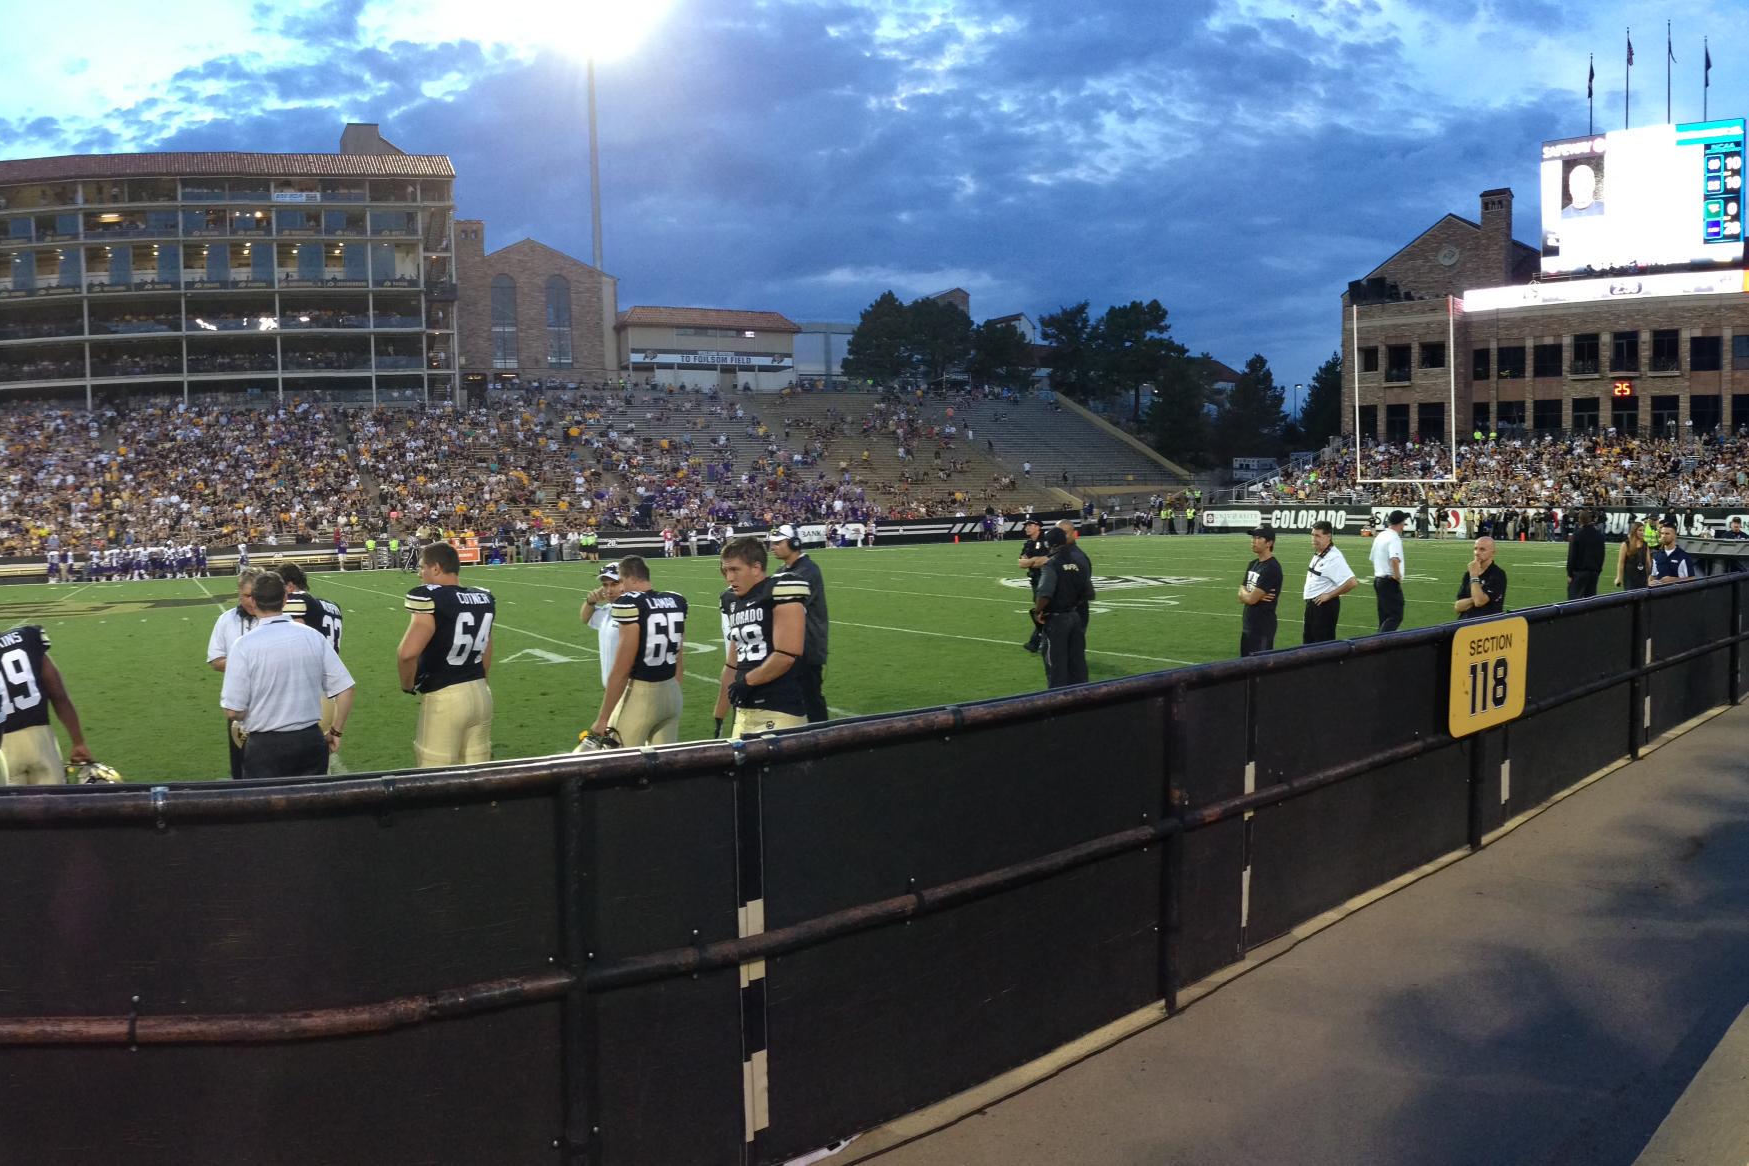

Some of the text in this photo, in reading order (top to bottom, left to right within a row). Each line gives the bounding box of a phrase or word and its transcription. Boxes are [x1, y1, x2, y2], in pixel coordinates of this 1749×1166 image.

[681, 355, 691, 363] TO
[731, 356, 752, 364] FIELD
[1614, 383, 1631, 395] 25
[1271, 509, 1347, 530] COLORADO
[446, 611, 494, 666] 64
[643, 612, 684, 667] 65
[1469, 633, 1513, 657] SECTION
[1468, 656, 1508, 718] 118
